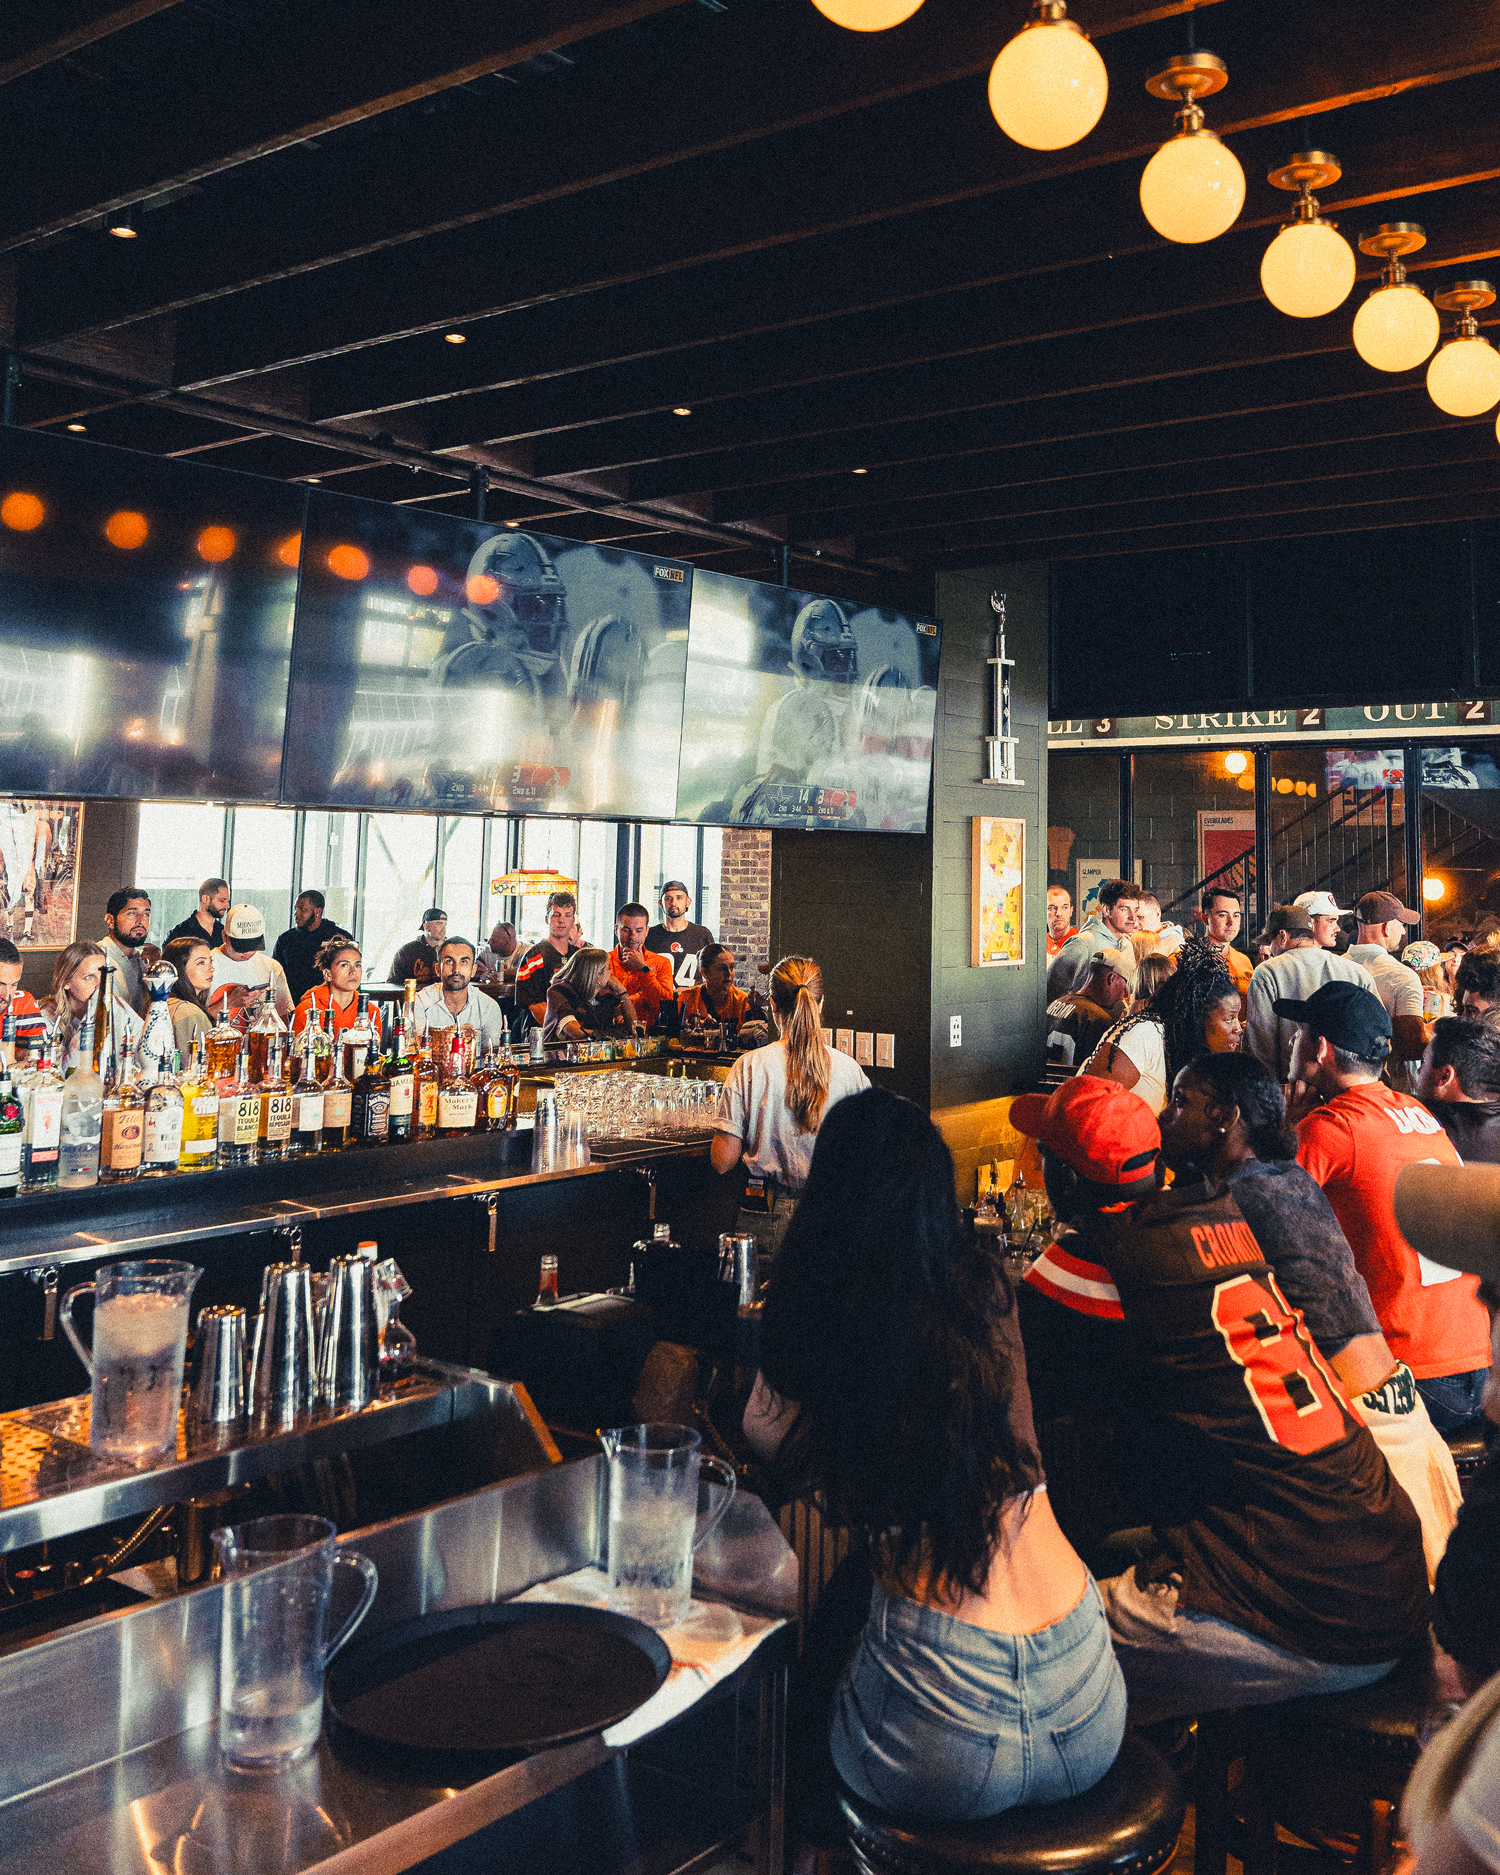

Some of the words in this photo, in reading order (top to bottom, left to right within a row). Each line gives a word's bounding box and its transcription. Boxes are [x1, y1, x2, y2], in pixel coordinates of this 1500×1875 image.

[655, 567, 669, 578] FOX
[1047, 719, 1083, 735] LL
[1096, 718, 1111, 733] 3
[1155, 709, 1287, 730] STRIKE
[1302, 708, 1320, 726] 2
[1363, 702, 1448, 722] OUT
[1465, 701, 1485, 720] 2
[511, 764, 521, 783] 3
[451, 782, 465, 792] 2ND
[512, 785, 525, 796] 2ND
[798, 788, 810, 804] 14
[817, 789, 825, 805] 3
[1081, 868, 1102, 876] GLAMPER
[238, 1101, 259, 1117] 818
[270, 1097, 292, 1114] 818
[237, 1116, 259, 1125] TEQUILA
[269, 1113, 291, 1121] TEQUILA
